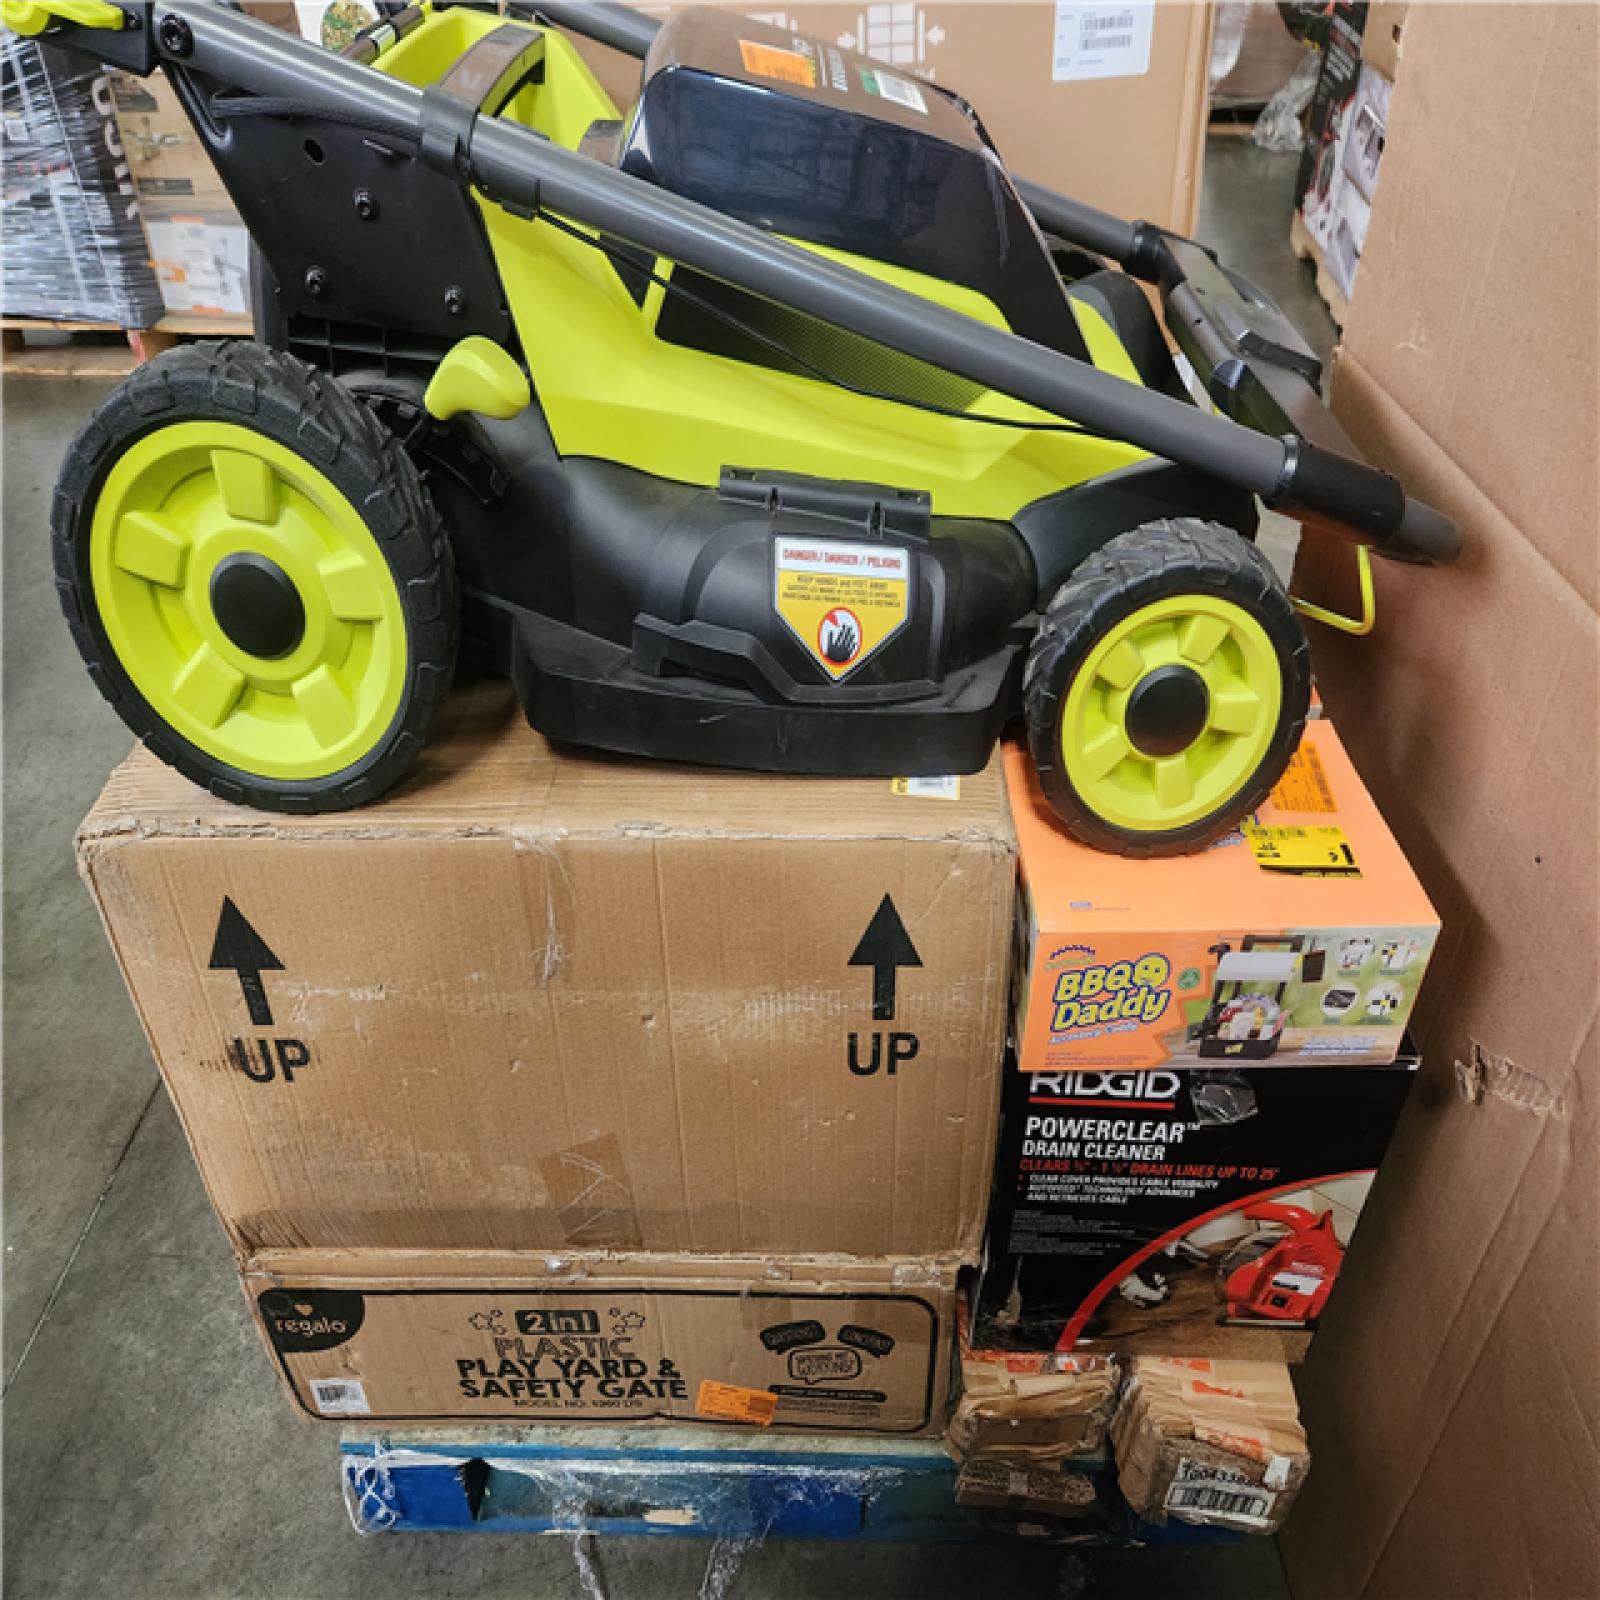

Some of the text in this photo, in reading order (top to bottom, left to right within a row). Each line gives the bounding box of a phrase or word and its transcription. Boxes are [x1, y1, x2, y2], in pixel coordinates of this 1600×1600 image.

[1053, 960, 1134, 1002] BBQ
[1050, 987, 1171, 1032] Daddy
[234, 1039, 310, 1083] UP
[847, 1032, 919, 1076] UP
[1029, 1071, 1181, 1099] RIDGID
[1022, 1140, 1165, 1161] DRAIN CLEANER
[1020, 1159, 1070, 1171] CLEARS
[1130, 1163, 1172, 1176] DRAIN
[1175, 1164, 1216, 1177] LINES
[1217, 1166, 1238, 1179] UP
[1240, 1167, 1257, 1180] TO
[275, 1317, 346, 1337] regalo
[494, 1337, 636, 1359] PLASTIC
[455, 1357, 681, 1378] PLAY YARD &
[458, 1379, 688, 1400] SAFETY GATE
[514, 1399, 561, 1408] MODEL
